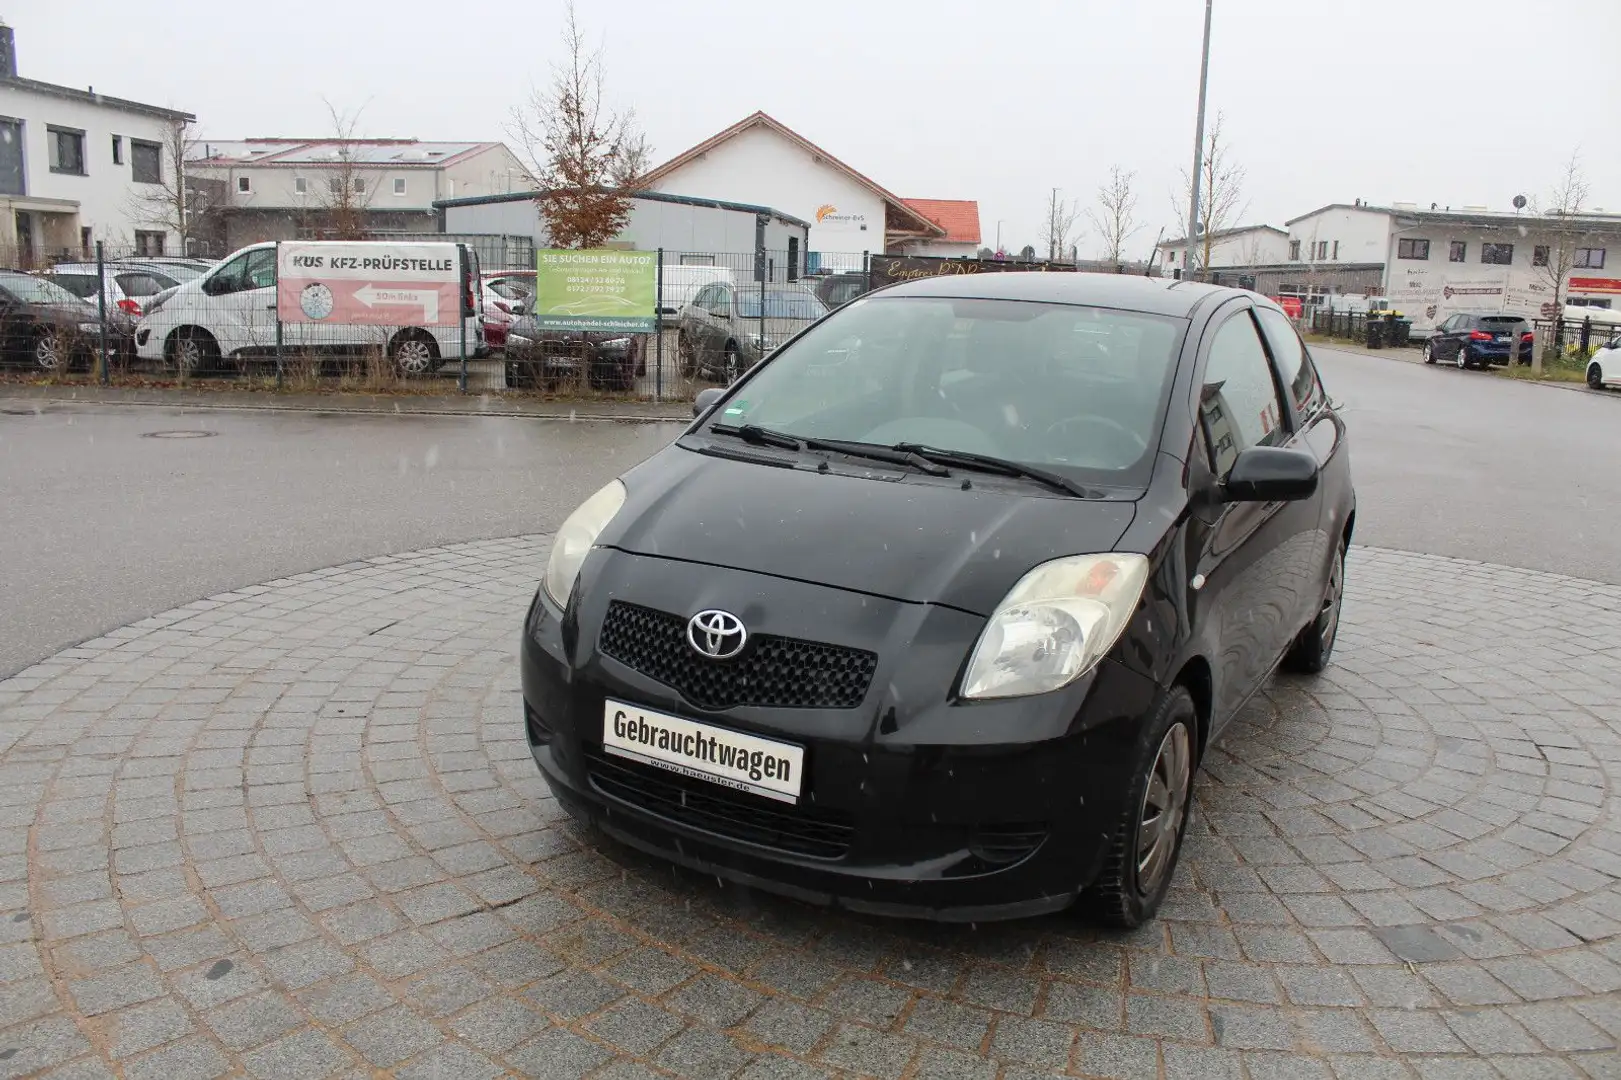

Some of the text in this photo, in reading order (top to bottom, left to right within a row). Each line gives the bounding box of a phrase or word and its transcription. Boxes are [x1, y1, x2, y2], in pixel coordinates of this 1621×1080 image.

[330, 255, 452, 271] KFZ-PRÜFSTELLE
[543, 254, 651, 265] SIE SUCHEN EIN AUTO?
[613, 709, 791, 782] Gebrauchtwagen
[651, 760, 750, 792] www.haeusler.de
